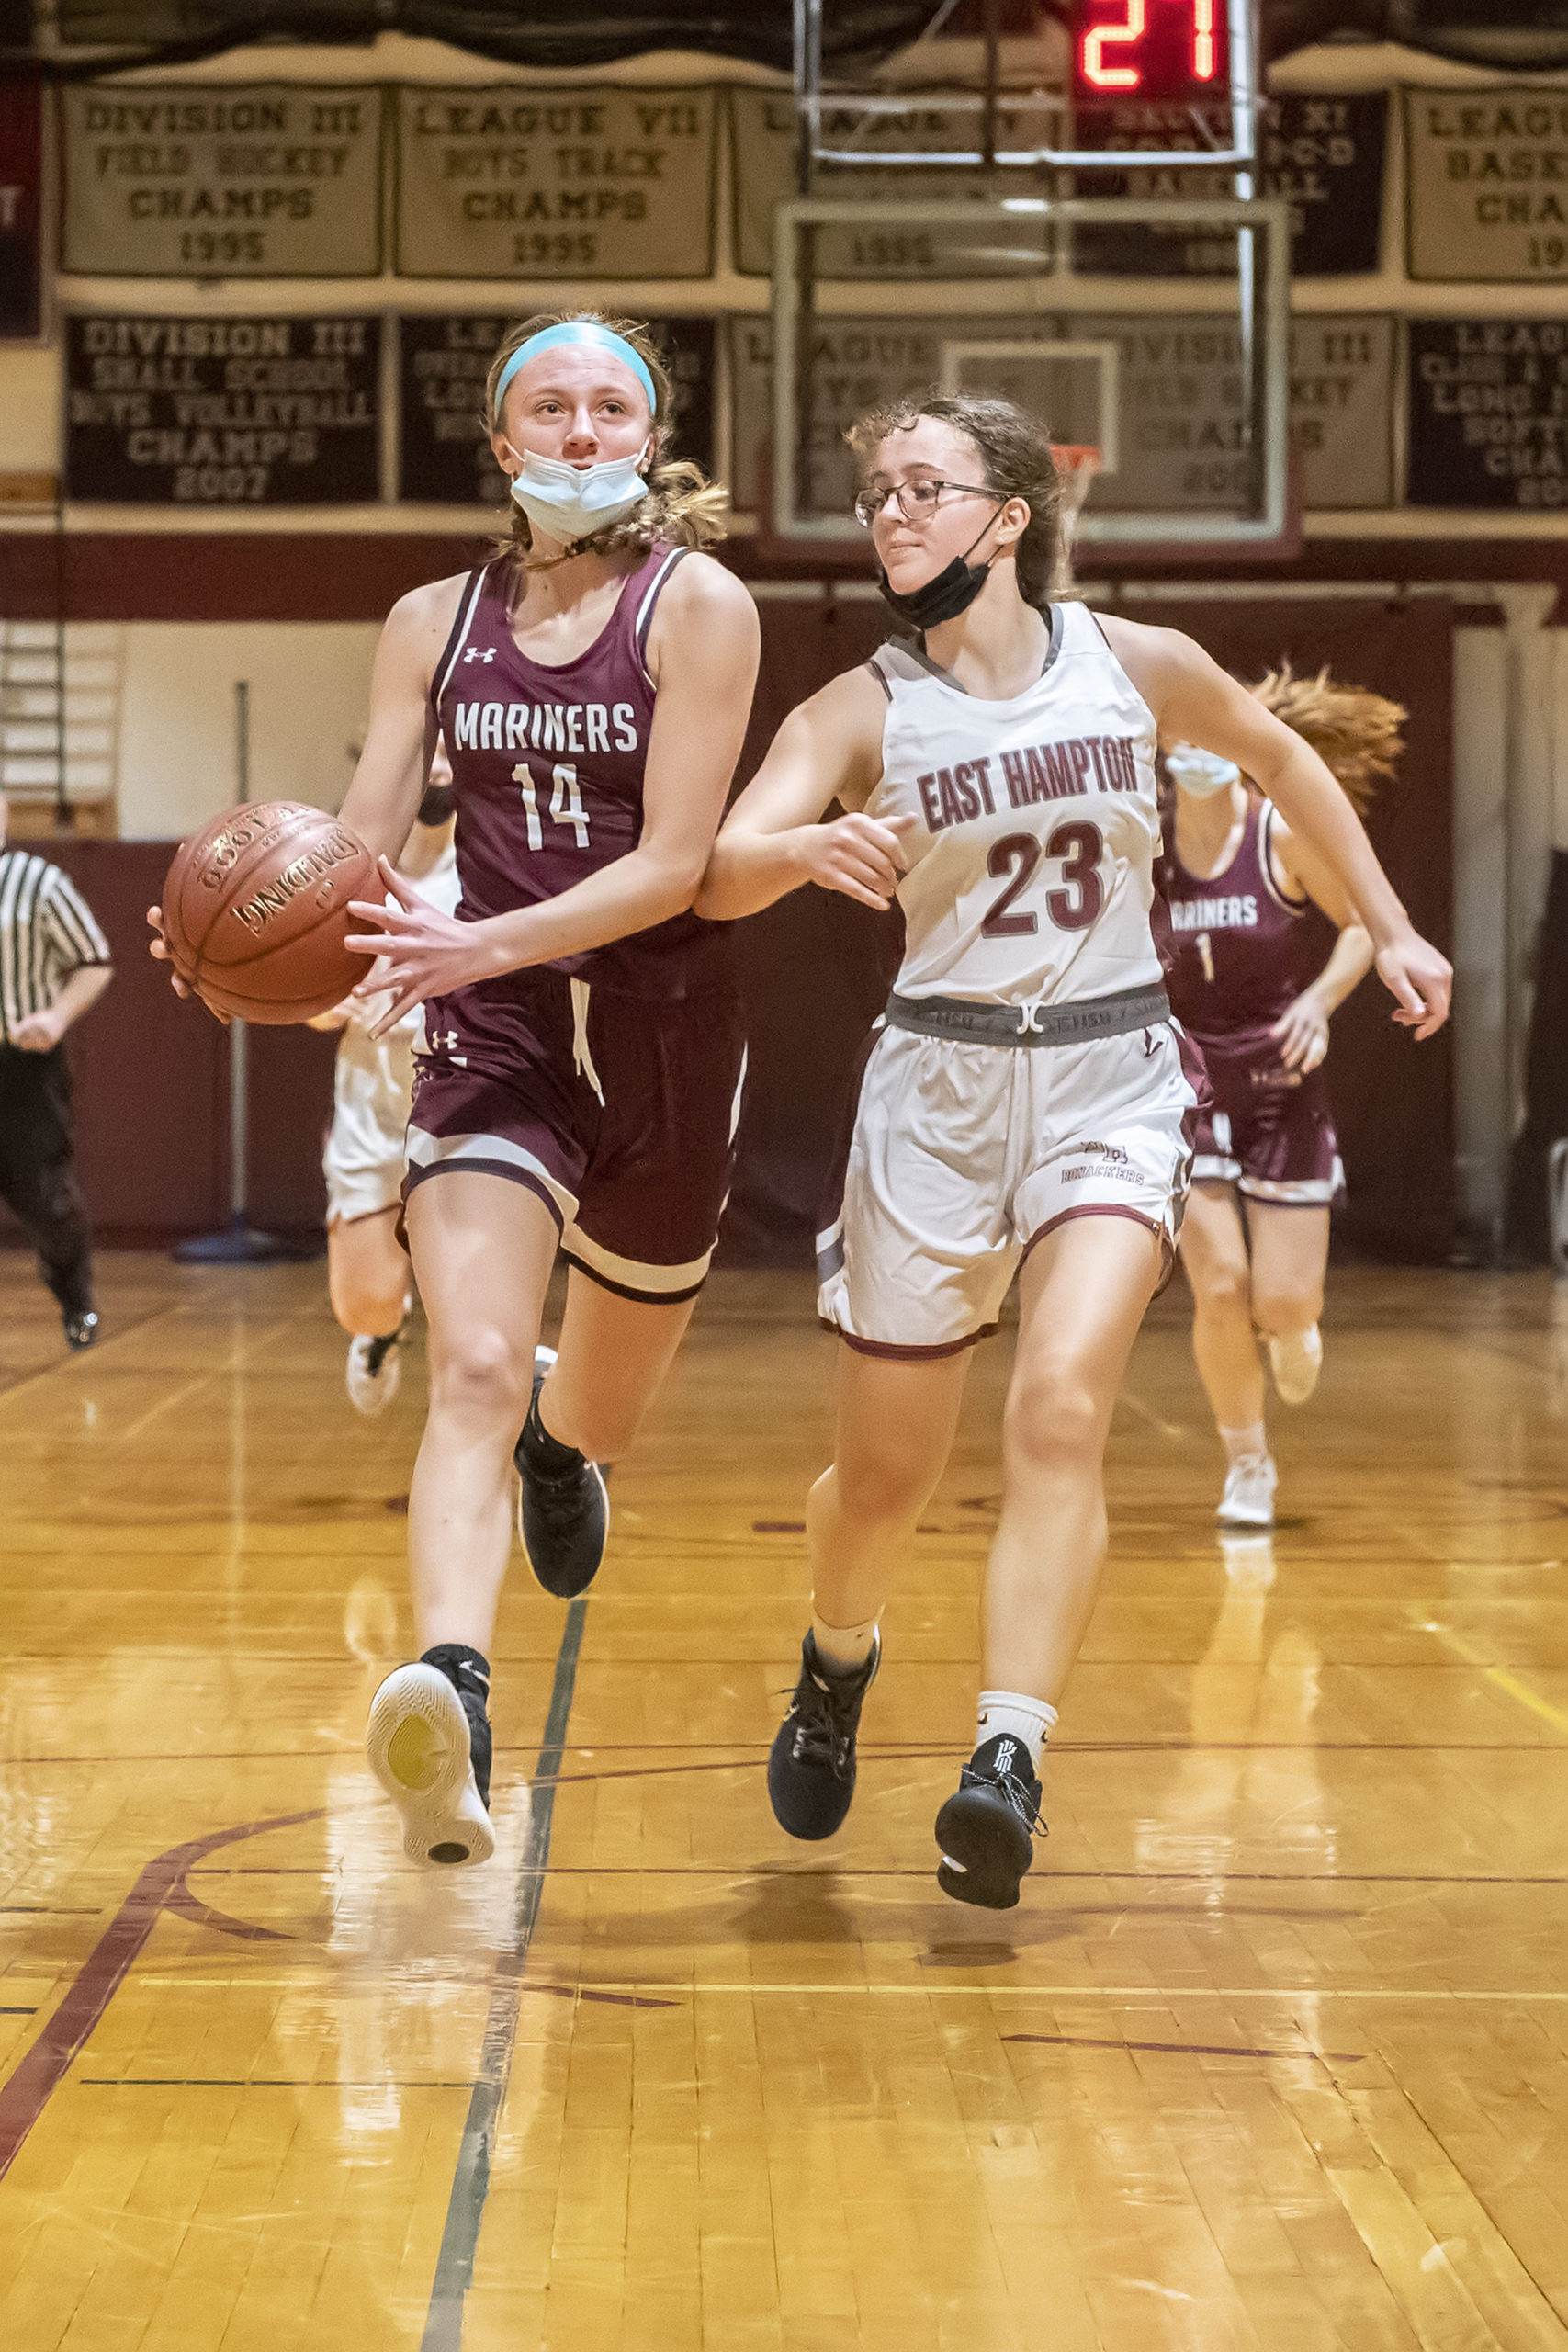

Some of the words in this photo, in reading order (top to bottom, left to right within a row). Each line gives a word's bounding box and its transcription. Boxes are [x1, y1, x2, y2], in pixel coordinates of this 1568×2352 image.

[85, 102, 288, 134] DIVISION
[312, 102, 361, 135] III
[415, 105, 604, 135] LEAGUE
[128, 187, 314, 220] CHAMPS
[462, 190, 647, 221] CHAMPS
[84, 320, 290, 356] DIVISION
[128, 429, 318, 464] CHAMPS
[454, 701, 639, 752] MARINERS
[917, 757, 997, 834] EAST
[999, 735, 1138, 808] HAMPTON
[511, 763, 591, 851] 14
[230, 828, 360, 938] SPALDING
[980, 820, 1104, 939] 23
